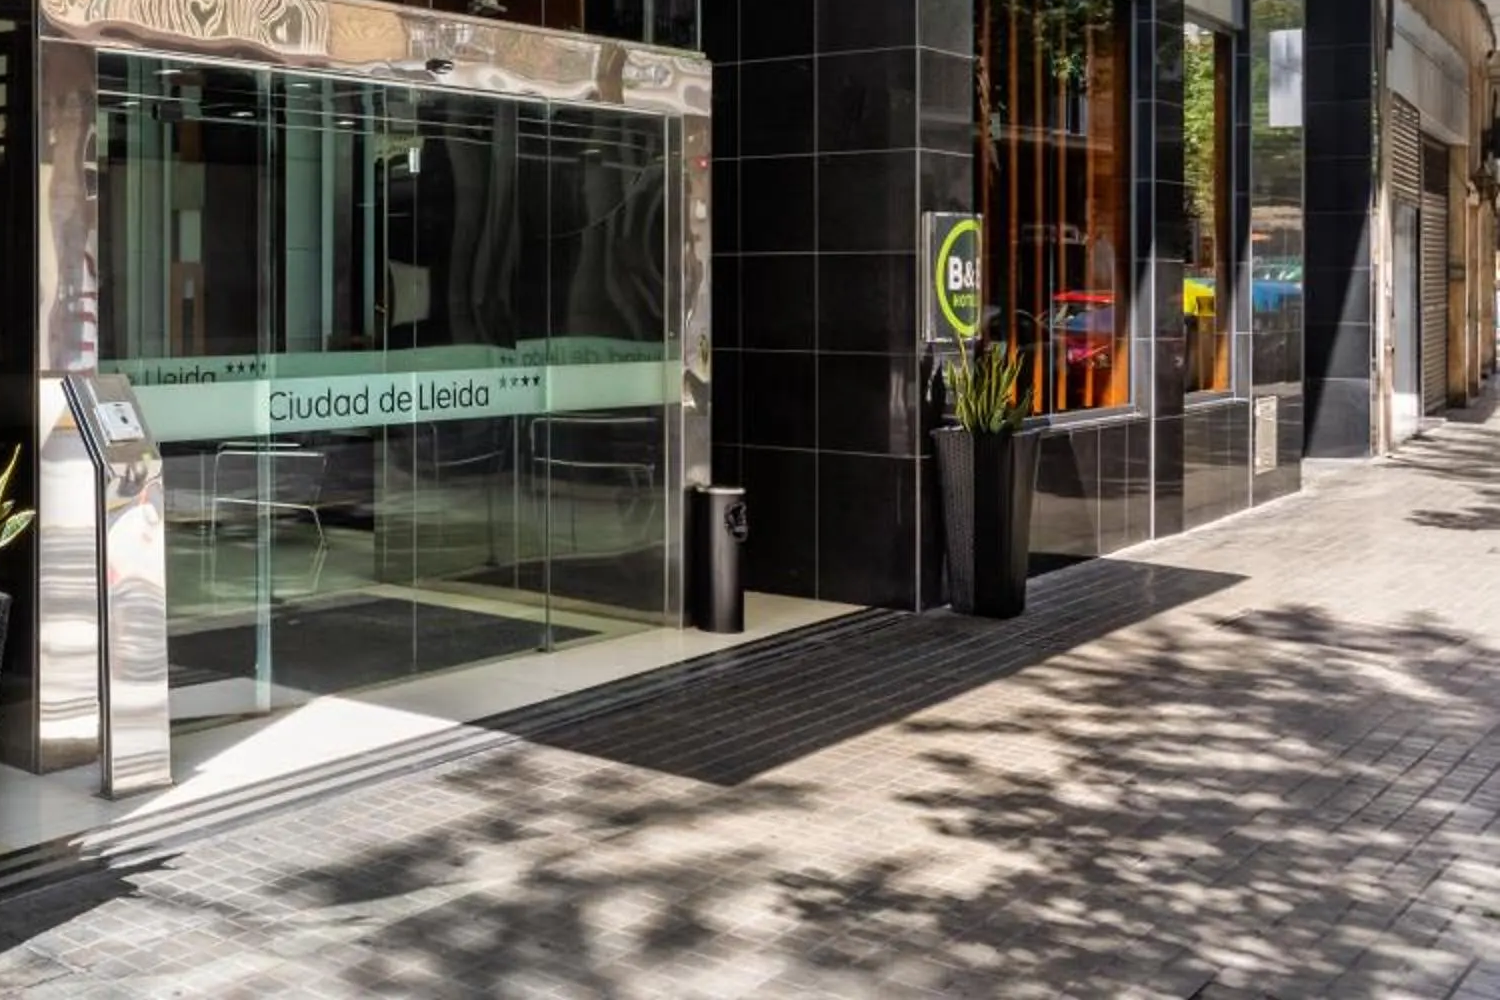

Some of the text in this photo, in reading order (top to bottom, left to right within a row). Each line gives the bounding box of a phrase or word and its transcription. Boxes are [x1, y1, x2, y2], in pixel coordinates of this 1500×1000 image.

[948, 255, 981, 290] B&
[268, 377, 490, 421] Ciudad de Lleida
